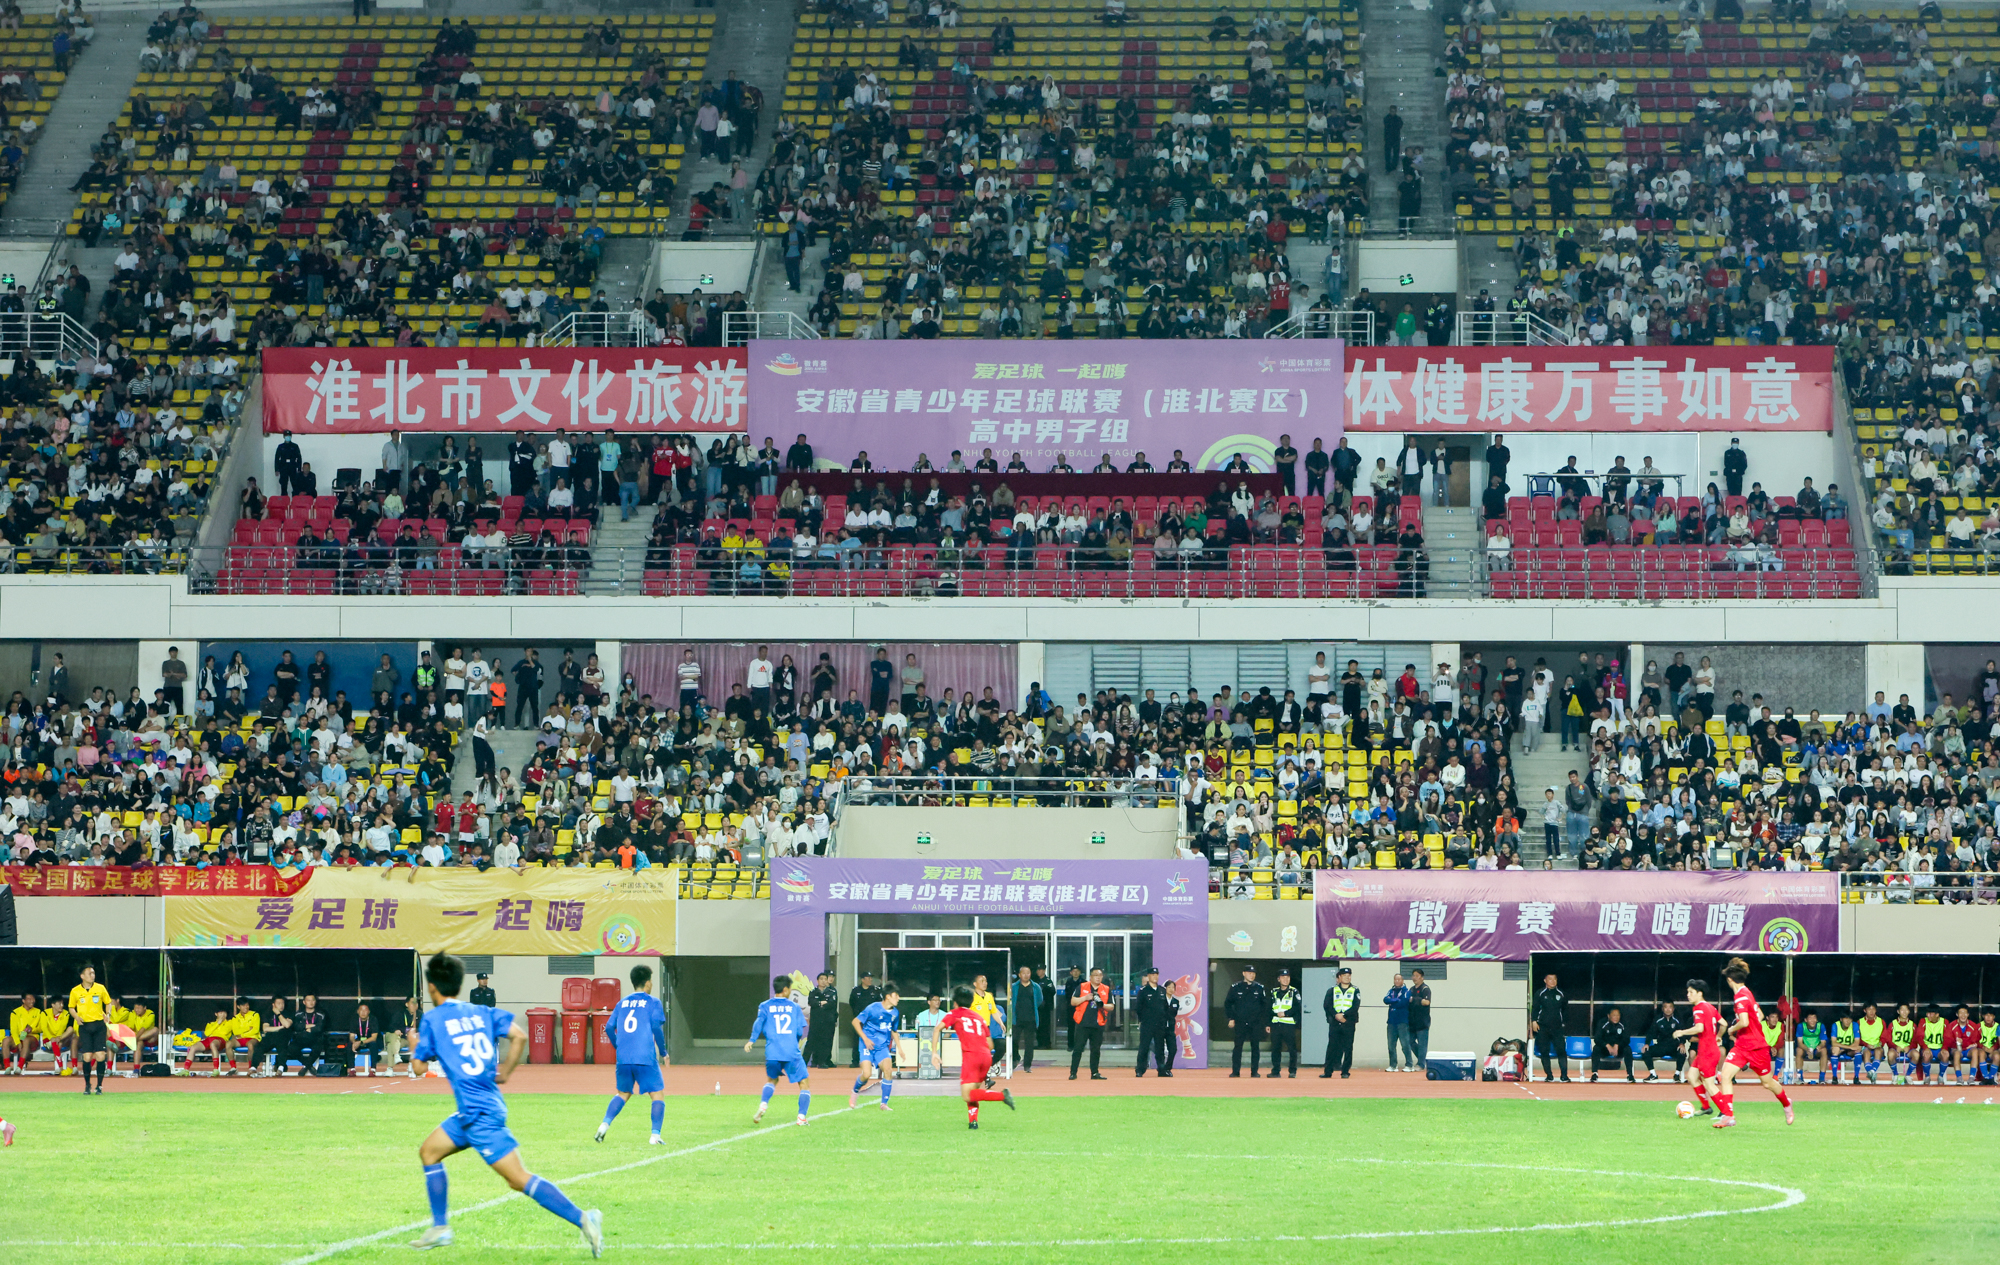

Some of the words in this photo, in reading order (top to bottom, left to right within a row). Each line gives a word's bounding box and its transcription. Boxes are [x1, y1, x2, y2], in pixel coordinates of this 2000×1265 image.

[973, 363, 1046, 380] 爱足球
[1057, 363, 1130, 381] 一起嗨
[305, 357, 748, 426] 淮北市文化旅游
[1344, 356, 1801, 426] 体健康万事如意
[968, 419, 1129, 443] 高中男子组
[922, 866, 984, 881] 爱足球
[993, 867, 1055, 881] 一起嗨
[255, 898, 397, 930] 爱足球
[441, 898, 585, 931] 一起嗨
[911, 903, 940, 911] ANHUI
[977, 904, 1025, 912] FOOTBALL
[1028, 904, 1064, 912] LEAGUE
[1408, 900, 1554, 935] 徽青赛
[1598, 901, 1746, 936] 嗨嗨嗨
[624, 1009, 637, 1033] 6
[773, 1014, 792, 1034] 12
[961, 1016, 983, 1036] 21
[1895, 1031, 1910, 1043] 30
[452, 1032, 494, 1076] 30
